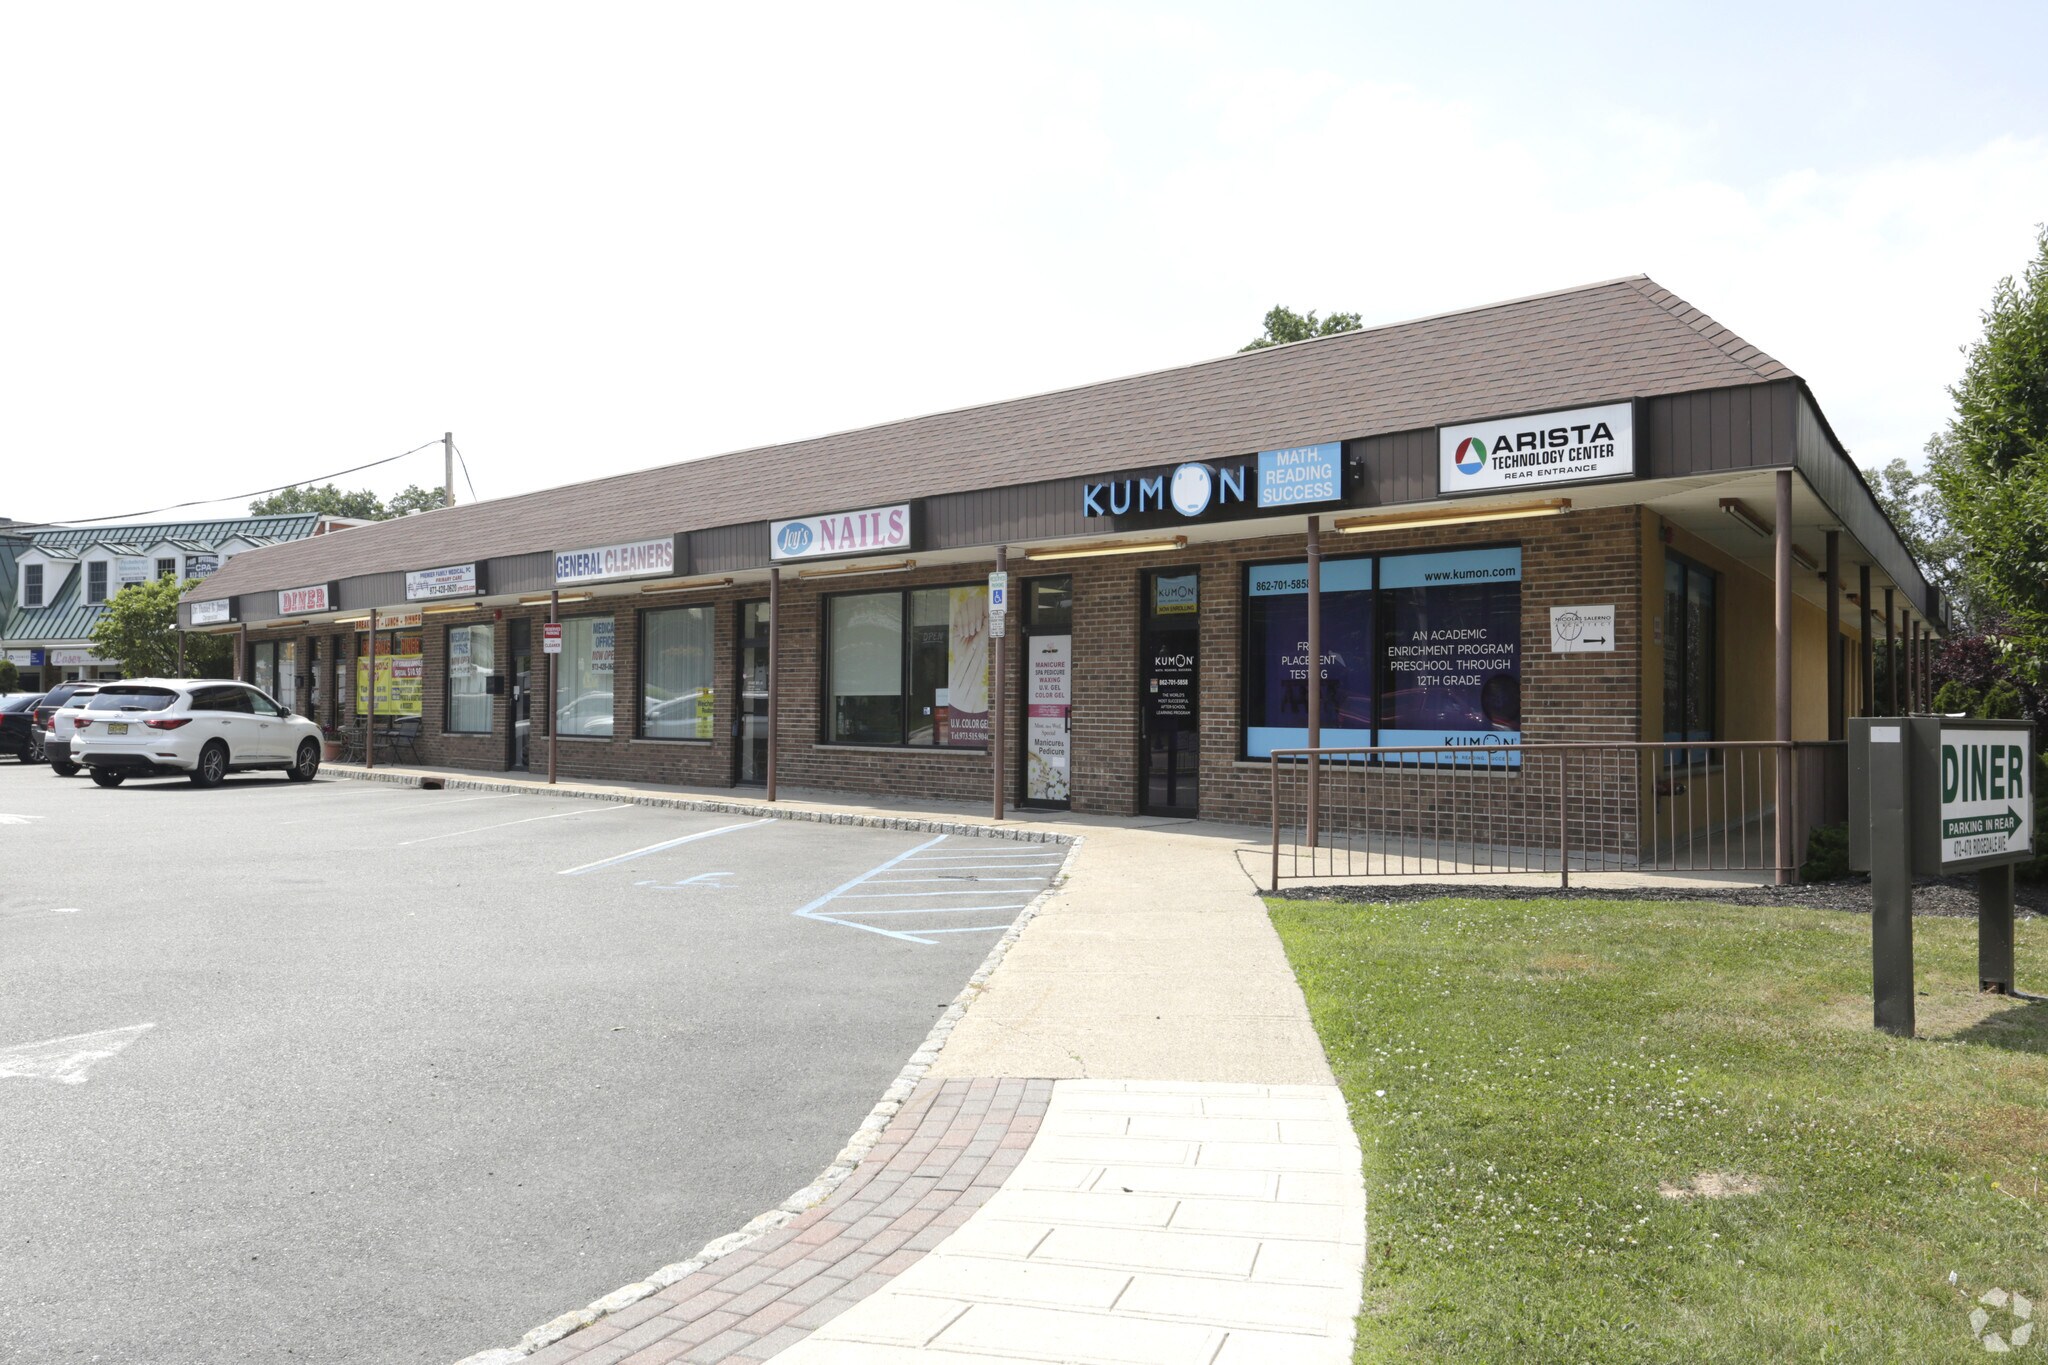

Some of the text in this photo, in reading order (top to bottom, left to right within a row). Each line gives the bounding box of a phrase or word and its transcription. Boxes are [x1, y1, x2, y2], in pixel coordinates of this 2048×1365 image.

[1491, 422, 1615, 455] ARISTA
[1277, 448, 1323, 467] MATH.
[1492, 444, 1614, 470] TECHNOLOGY CENTER
[1265, 464, 1332, 485] READING
[1504, 464, 1598, 480] REAR ENTRANCE
[1083, 463, 1246, 518] KUMON
[1263, 482, 1333, 504] SUCCESS
[782, 510, 904, 551] Joy's NAILS
[556, 541, 673, 578] GENERAL CLEANERS
[195, 564, 212, 572] CPA
[420, 570, 436, 579] PREMIER
[436, 569, 448, 578] FAMILY
[1424, 567, 1516, 582] www.kumon.com
[1159, 585, 1194, 598] KUMON
[283, 588, 325, 612] DINER
[384, 616, 399, 628] LUNCH
[405, 613, 422, 626] DINNER
[922, 632, 943, 641] OPEN
[1412, 628, 1487, 641] AN ACADEMIC
[53, 650, 81, 664] Laser
[592, 651, 604, 661] NOW
[1388, 643, 1514, 657] ENRICHMENT PROGRAM
[1155, 654, 1193, 667] KUMON
[1281, 654, 1337, 666] PLACEENT
[1390, 659, 1511, 672] PRESCHOOL THROUGH
[1416, 674, 1481, 687] 12TH GRADE
[950, 719, 961, 729] U.V.
[961, 719, 979, 729] COLOR
[1038, 746, 1065, 756] Pedicure
[1942, 744, 2023, 804] DINER
[1948, 817, 2015, 836] PARKING IN REAR
[1972, 836, 1998, 856] RIDGEDALE
